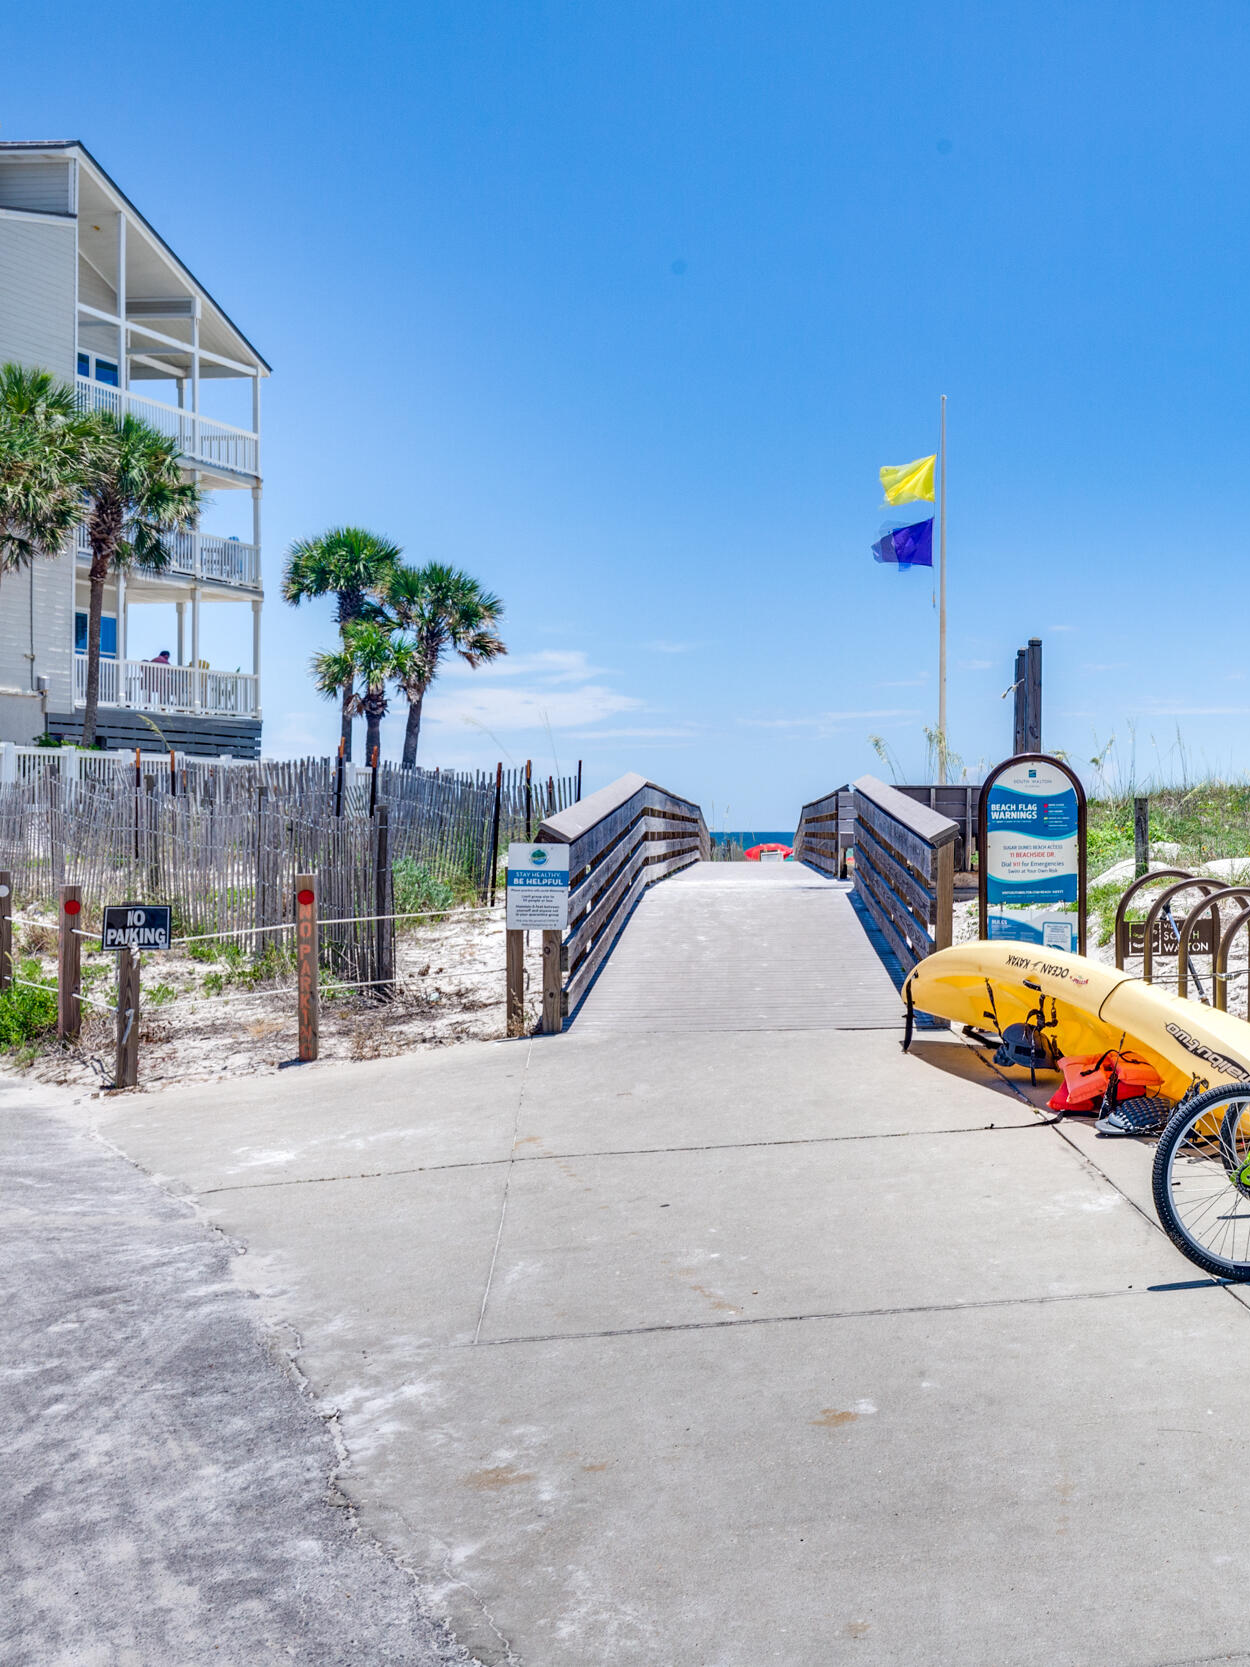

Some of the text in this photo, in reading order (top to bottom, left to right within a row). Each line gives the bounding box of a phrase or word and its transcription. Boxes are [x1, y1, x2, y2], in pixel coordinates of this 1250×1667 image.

[991, 811, 1038, 820] WARNINGS
[127, 910, 146, 927] NO
[107, 928, 166, 945] PARKING
[1163, 931, 1200, 941] SOH
[1163, 942, 1209, 953] WATON
[1006, 955, 1069, 979] OCEAN KAYAK
[1166, 1023, 1200, 1052] two
